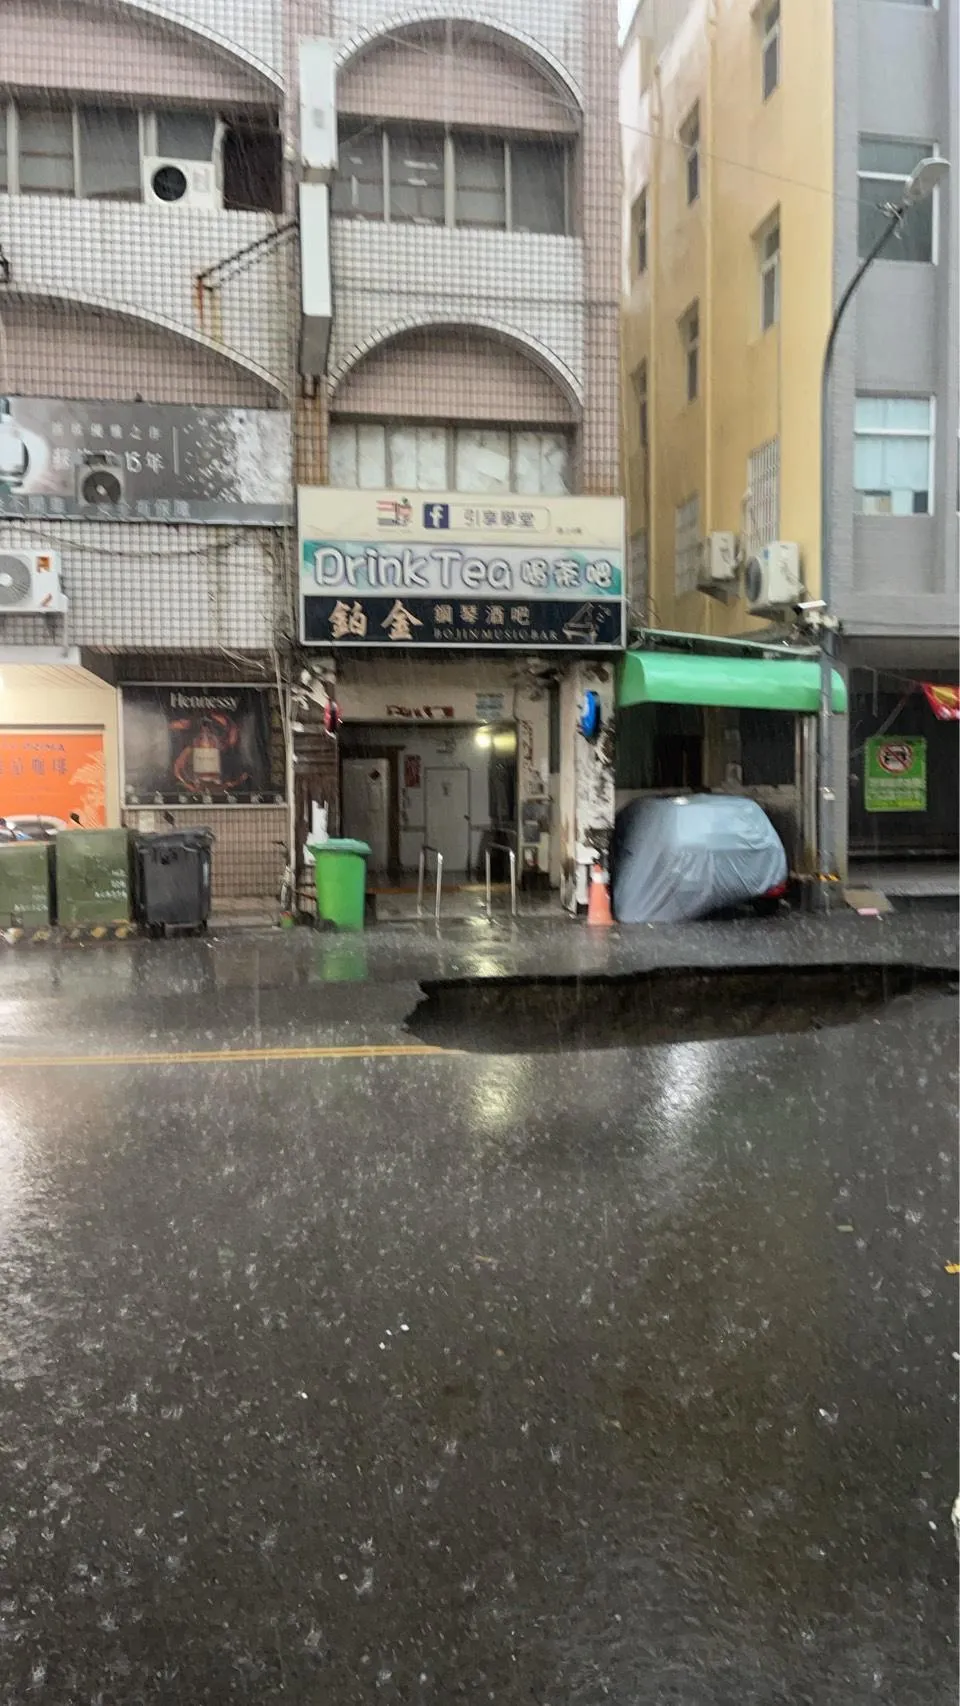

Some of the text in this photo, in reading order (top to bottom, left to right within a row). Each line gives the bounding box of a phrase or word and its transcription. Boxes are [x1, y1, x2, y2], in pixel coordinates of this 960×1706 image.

[520, 558, 613, 589] 喝茶吧
[433, 603, 531, 627] 鋼琴酒吧
[169, 691, 239, 712] Hennessy
